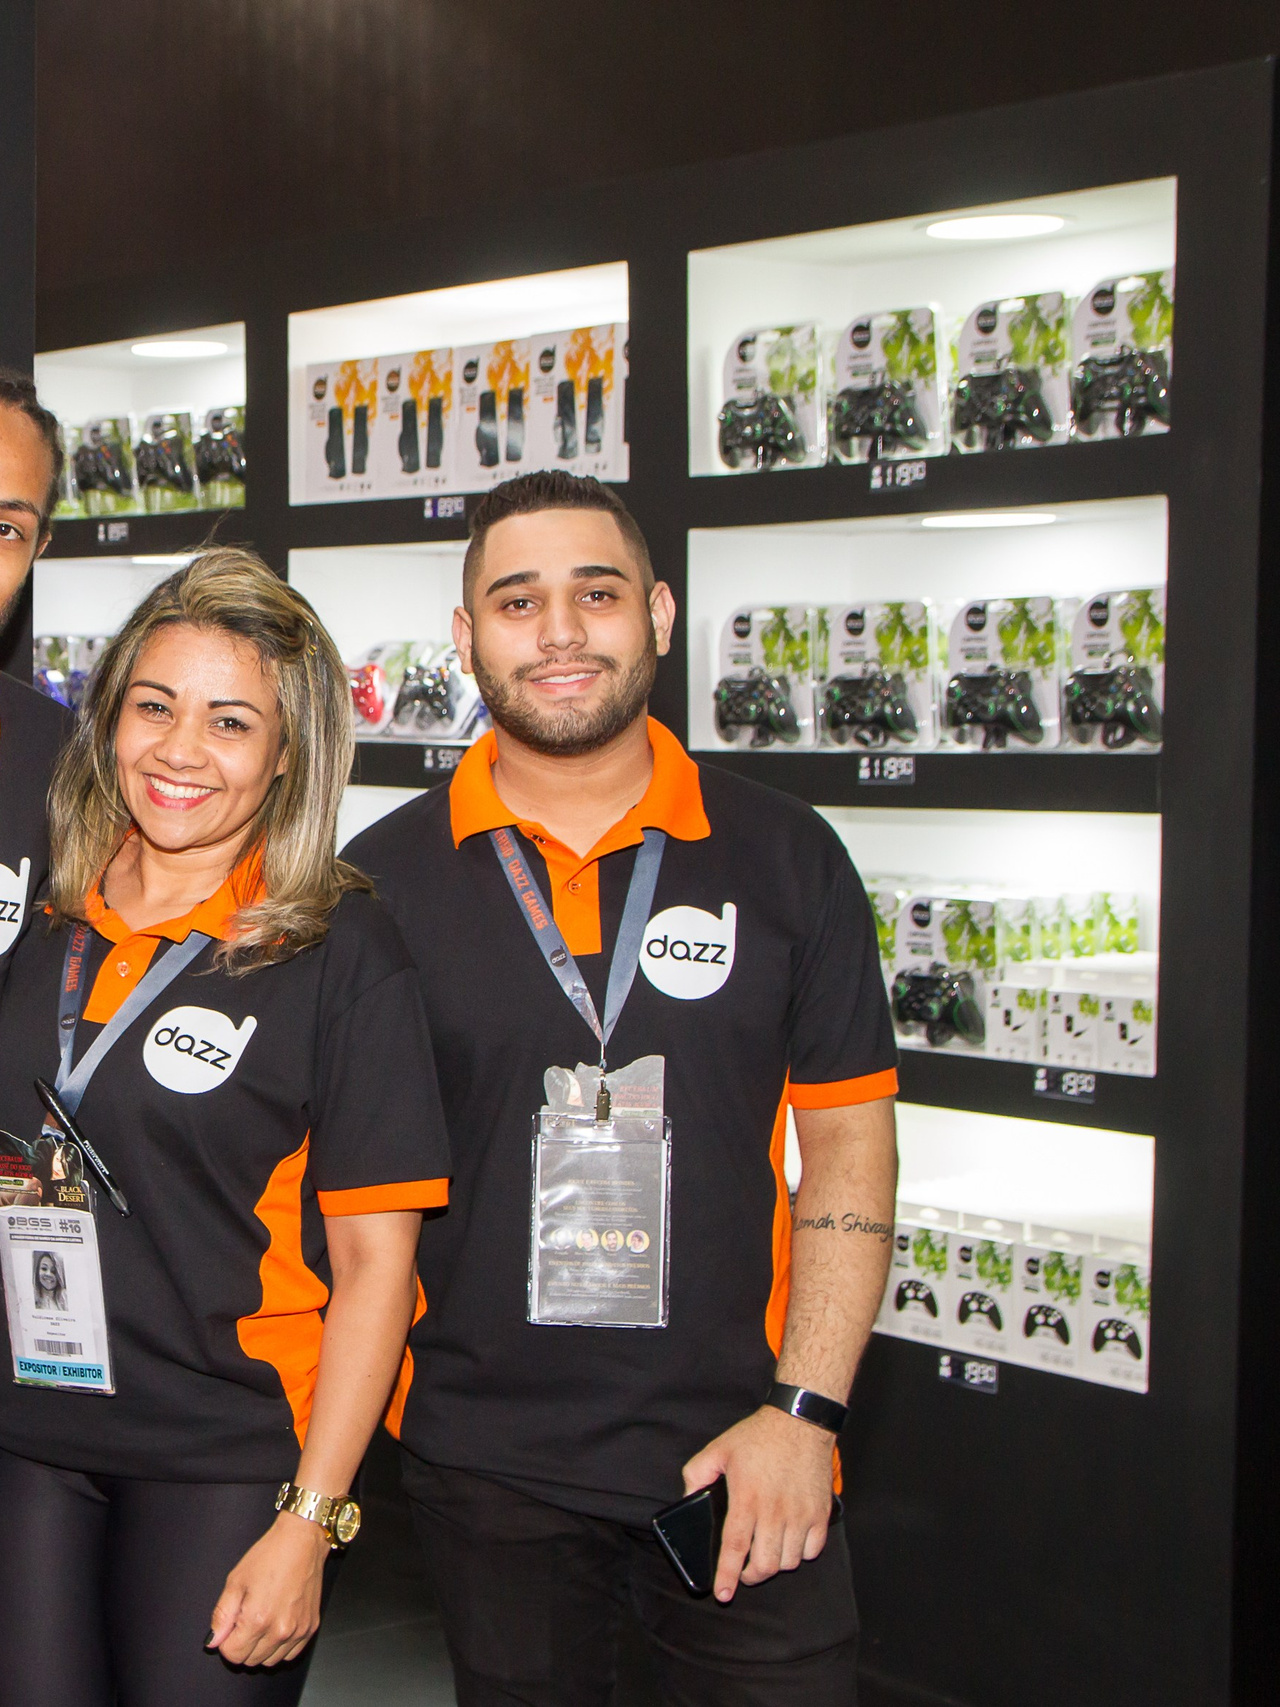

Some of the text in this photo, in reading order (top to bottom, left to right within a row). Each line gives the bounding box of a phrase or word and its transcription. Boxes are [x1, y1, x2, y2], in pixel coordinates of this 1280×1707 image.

[508, 859, 530, 890] DAZZ
[522, 890, 549, 931] GAMES
[646, 934, 727, 965] dazz
[65, 956, 82, 993] GAMES
[154, 1026, 232, 1070] dazz
[16, 1216, 52, 1227] BGS
[20, 1361, 57, 1376] EXPOSITOR
[62, 1366, 103, 1379] EXHIBITOR
